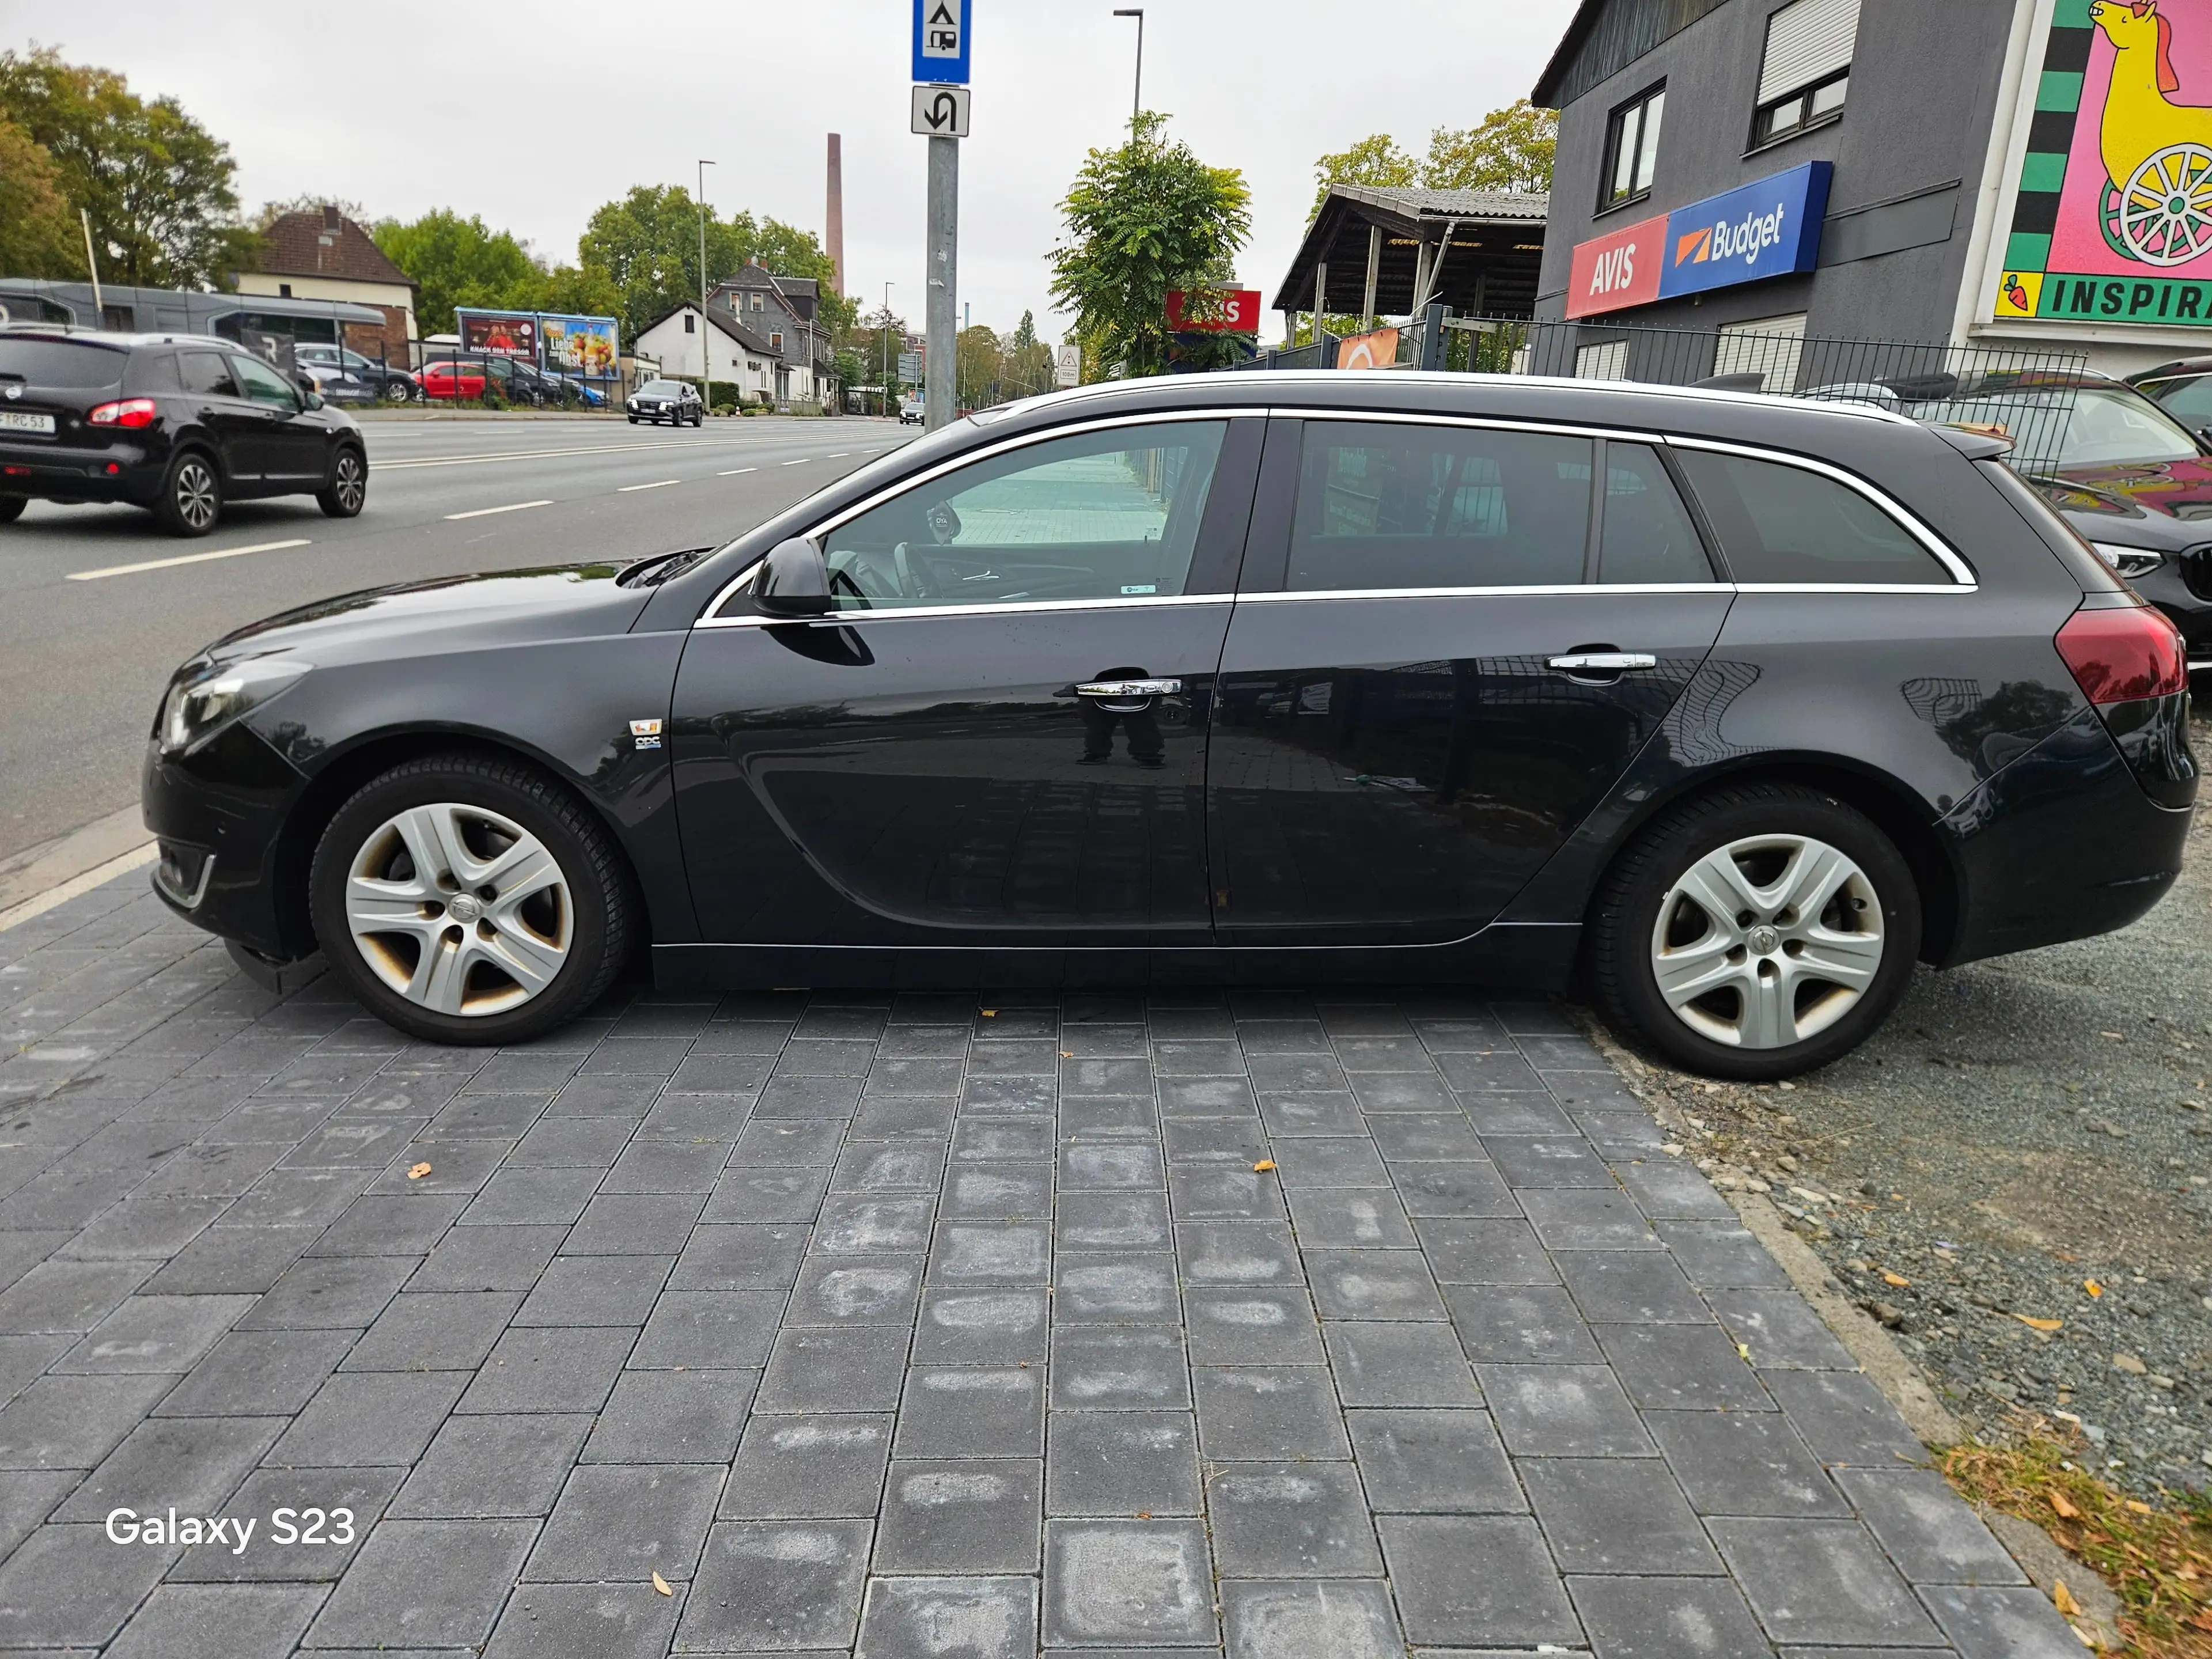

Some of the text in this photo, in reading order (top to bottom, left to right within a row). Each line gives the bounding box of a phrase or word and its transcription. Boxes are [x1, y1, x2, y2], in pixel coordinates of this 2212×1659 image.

[1589, 203, 1784, 296] AVIS Budget
[2052, 280, 2212, 319] INSPIR
